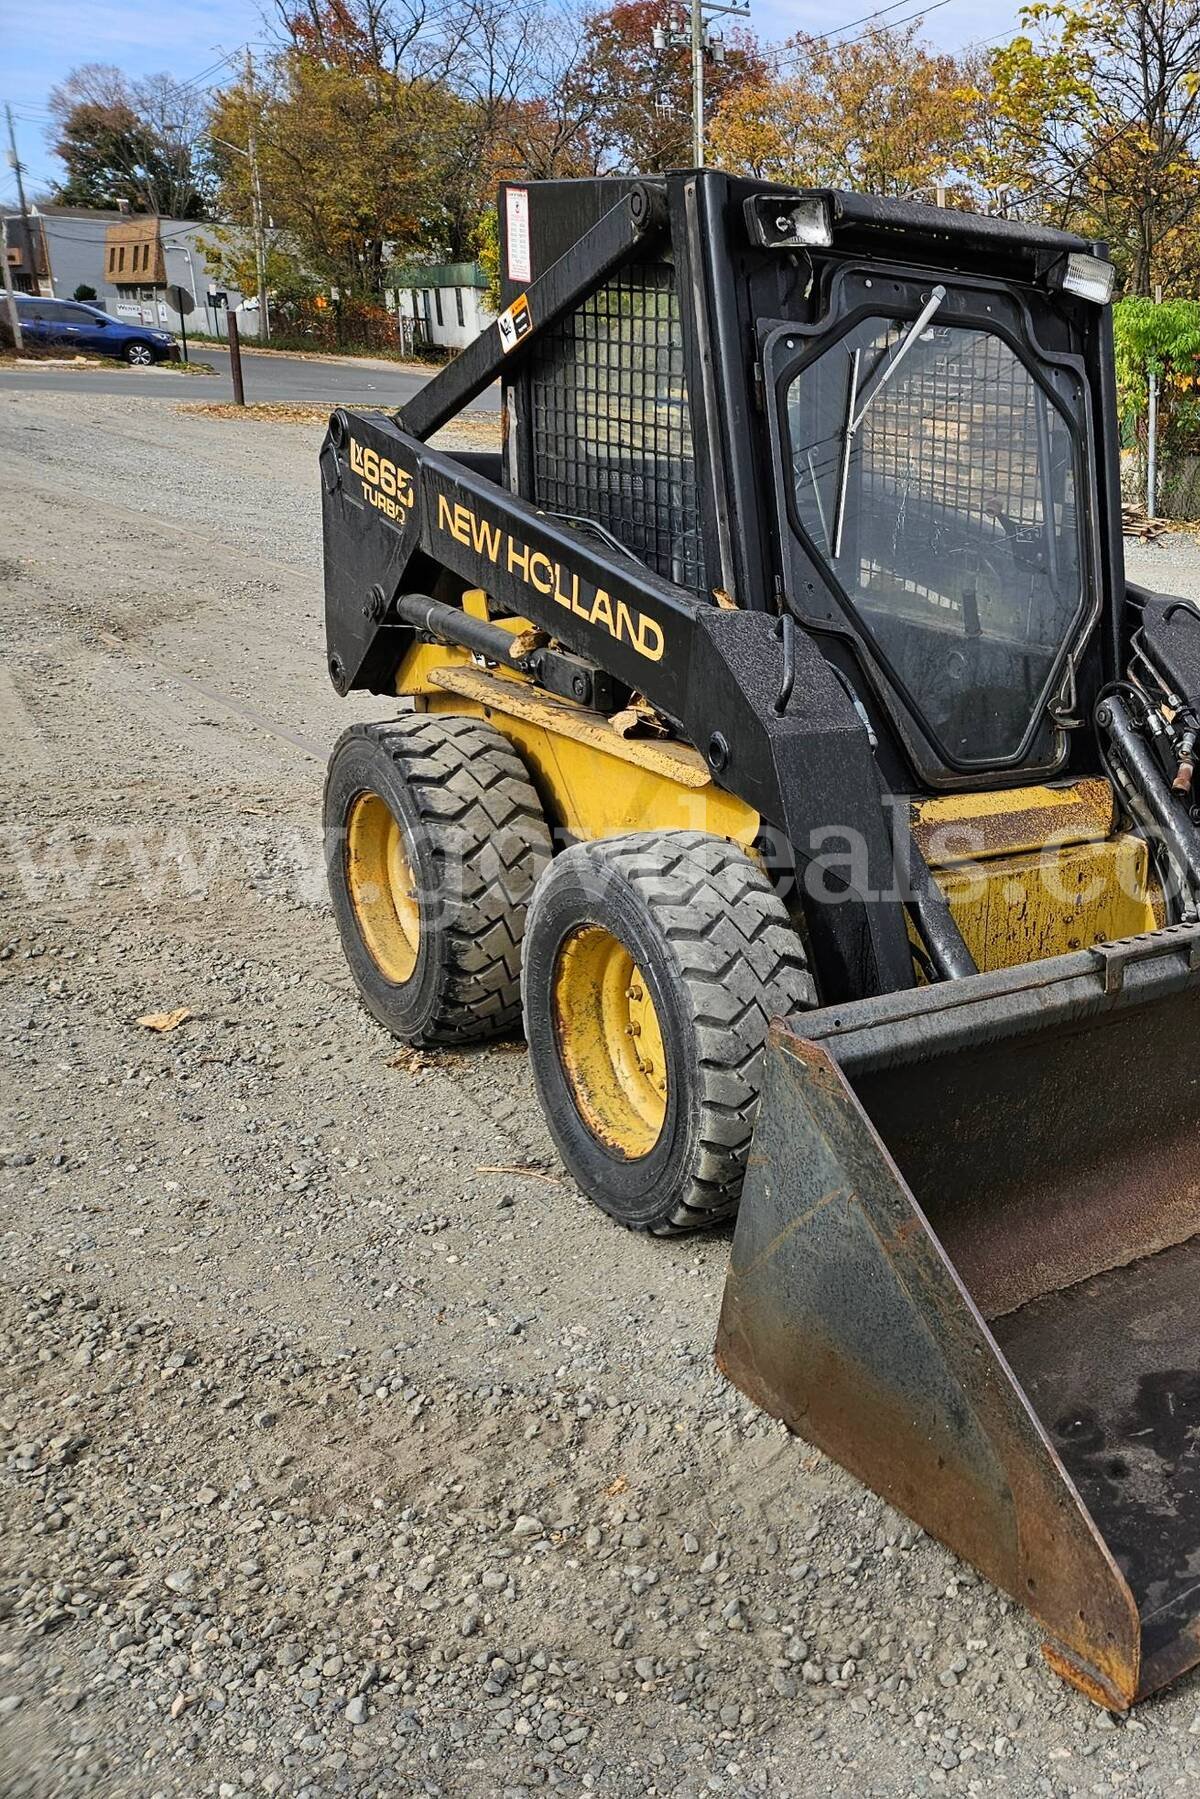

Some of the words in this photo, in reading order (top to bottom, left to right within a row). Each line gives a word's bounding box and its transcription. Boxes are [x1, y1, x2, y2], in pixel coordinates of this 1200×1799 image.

[350, 437, 414, 508] LX665
[361, 481, 406, 525] TURBO
[438, 494, 502, 563] NEW
[507, 535, 665, 661] HOLLAND
